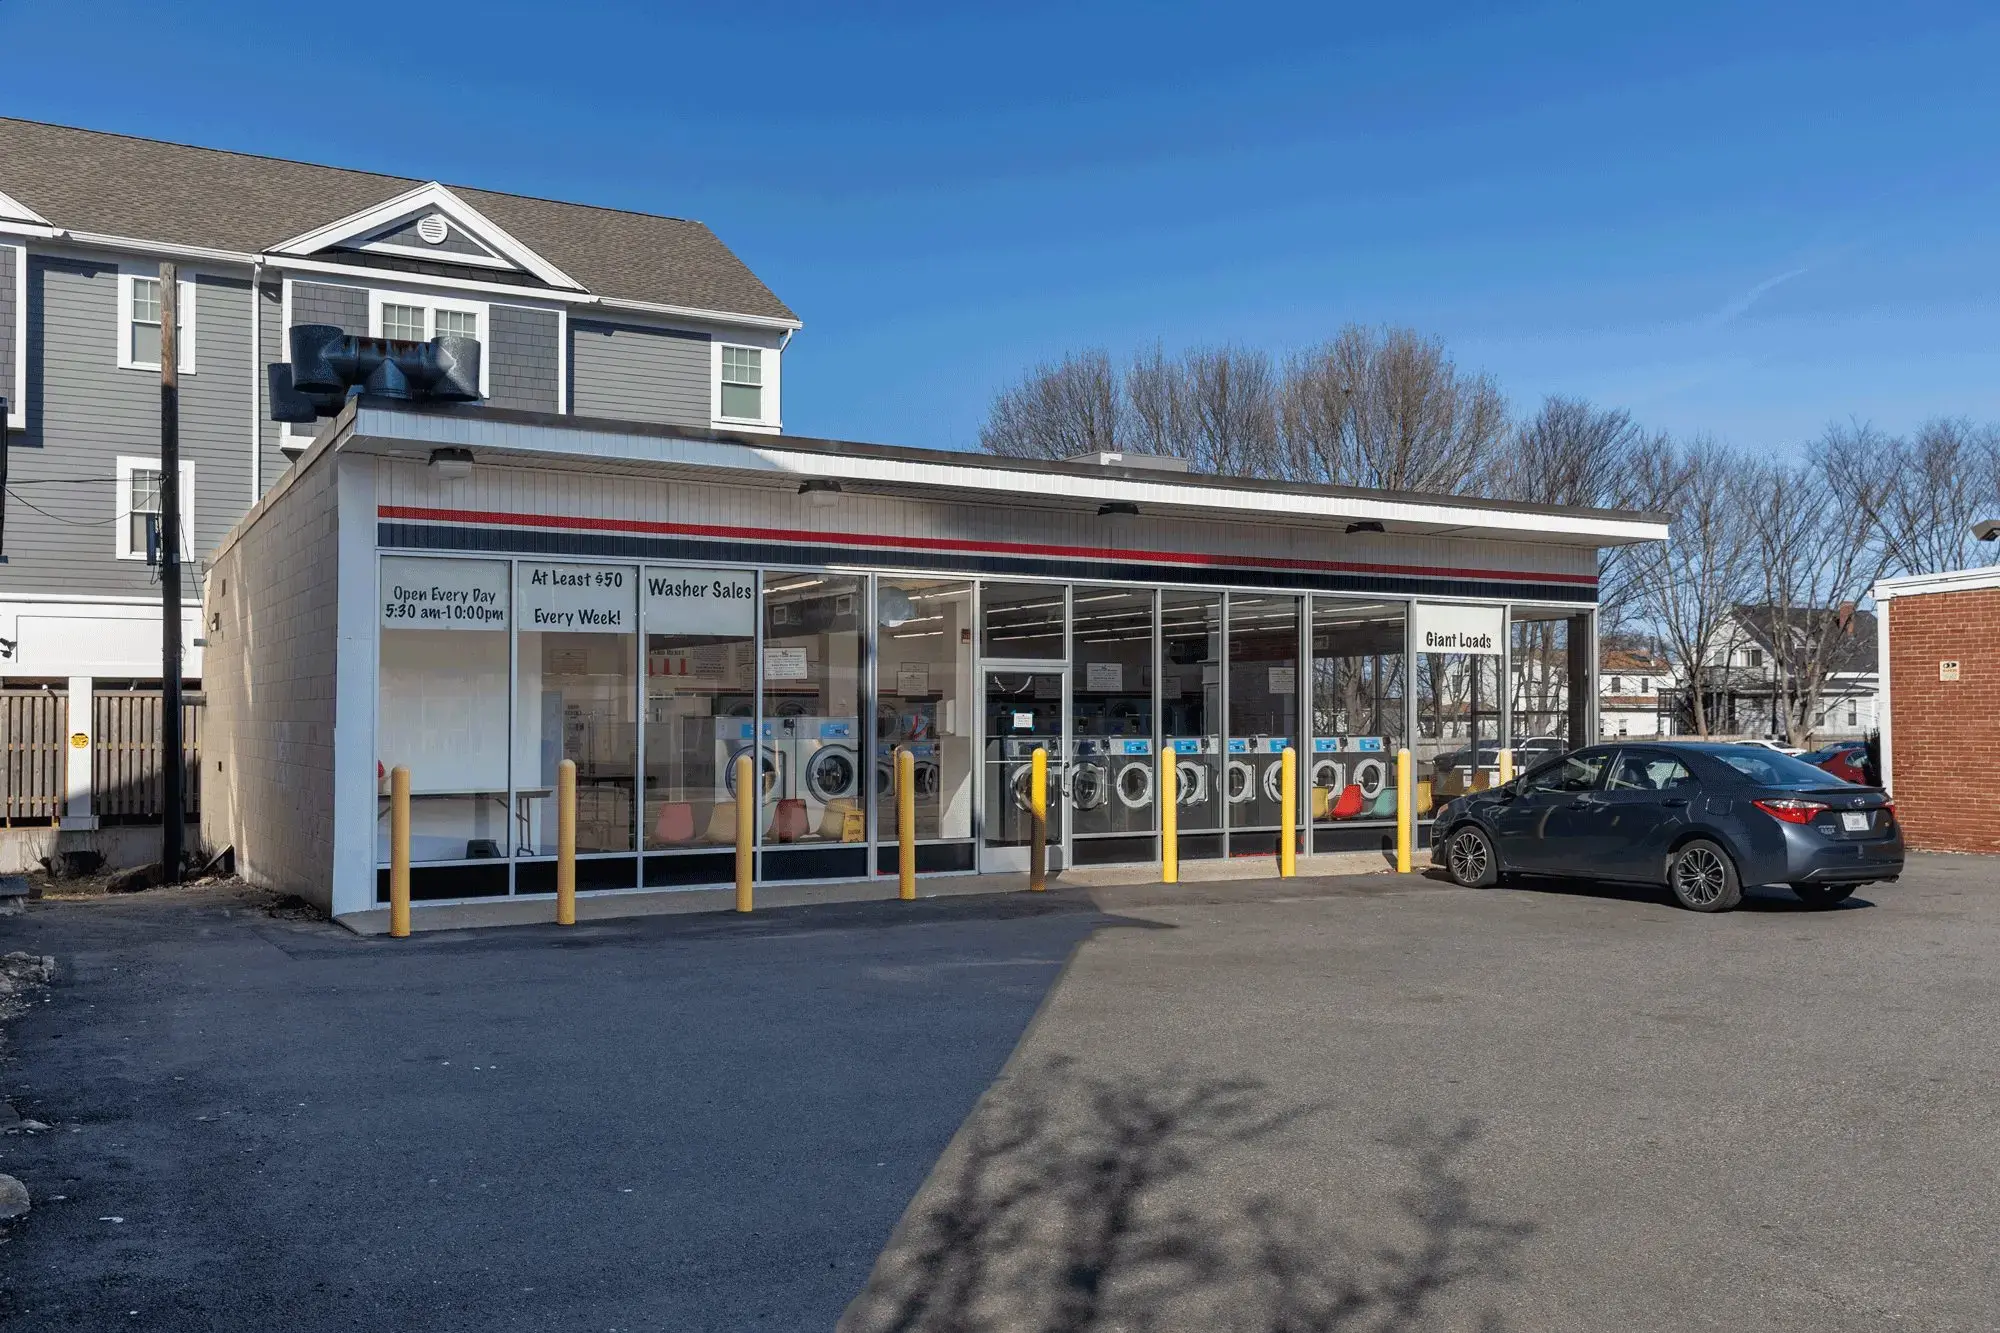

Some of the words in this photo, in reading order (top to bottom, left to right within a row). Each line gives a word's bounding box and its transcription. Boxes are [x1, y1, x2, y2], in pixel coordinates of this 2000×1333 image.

[531, 569, 548, 585] At
[552, 570, 591, 587] Least
[595, 571, 623, 588] $50
[393, 585, 427, 603] Open
[431, 587, 469, 604] Every
[473, 588, 496, 605] Day
[648, 578, 708, 597] Washer
[712, 580, 752, 599] Sales
[385, 603, 416, 619] 5:30
[534, 608, 574, 627] Every
[578, 609, 621, 625] Week!
[1426, 631, 1457, 648] Giant
[1459, 632, 1492, 649] Loads
